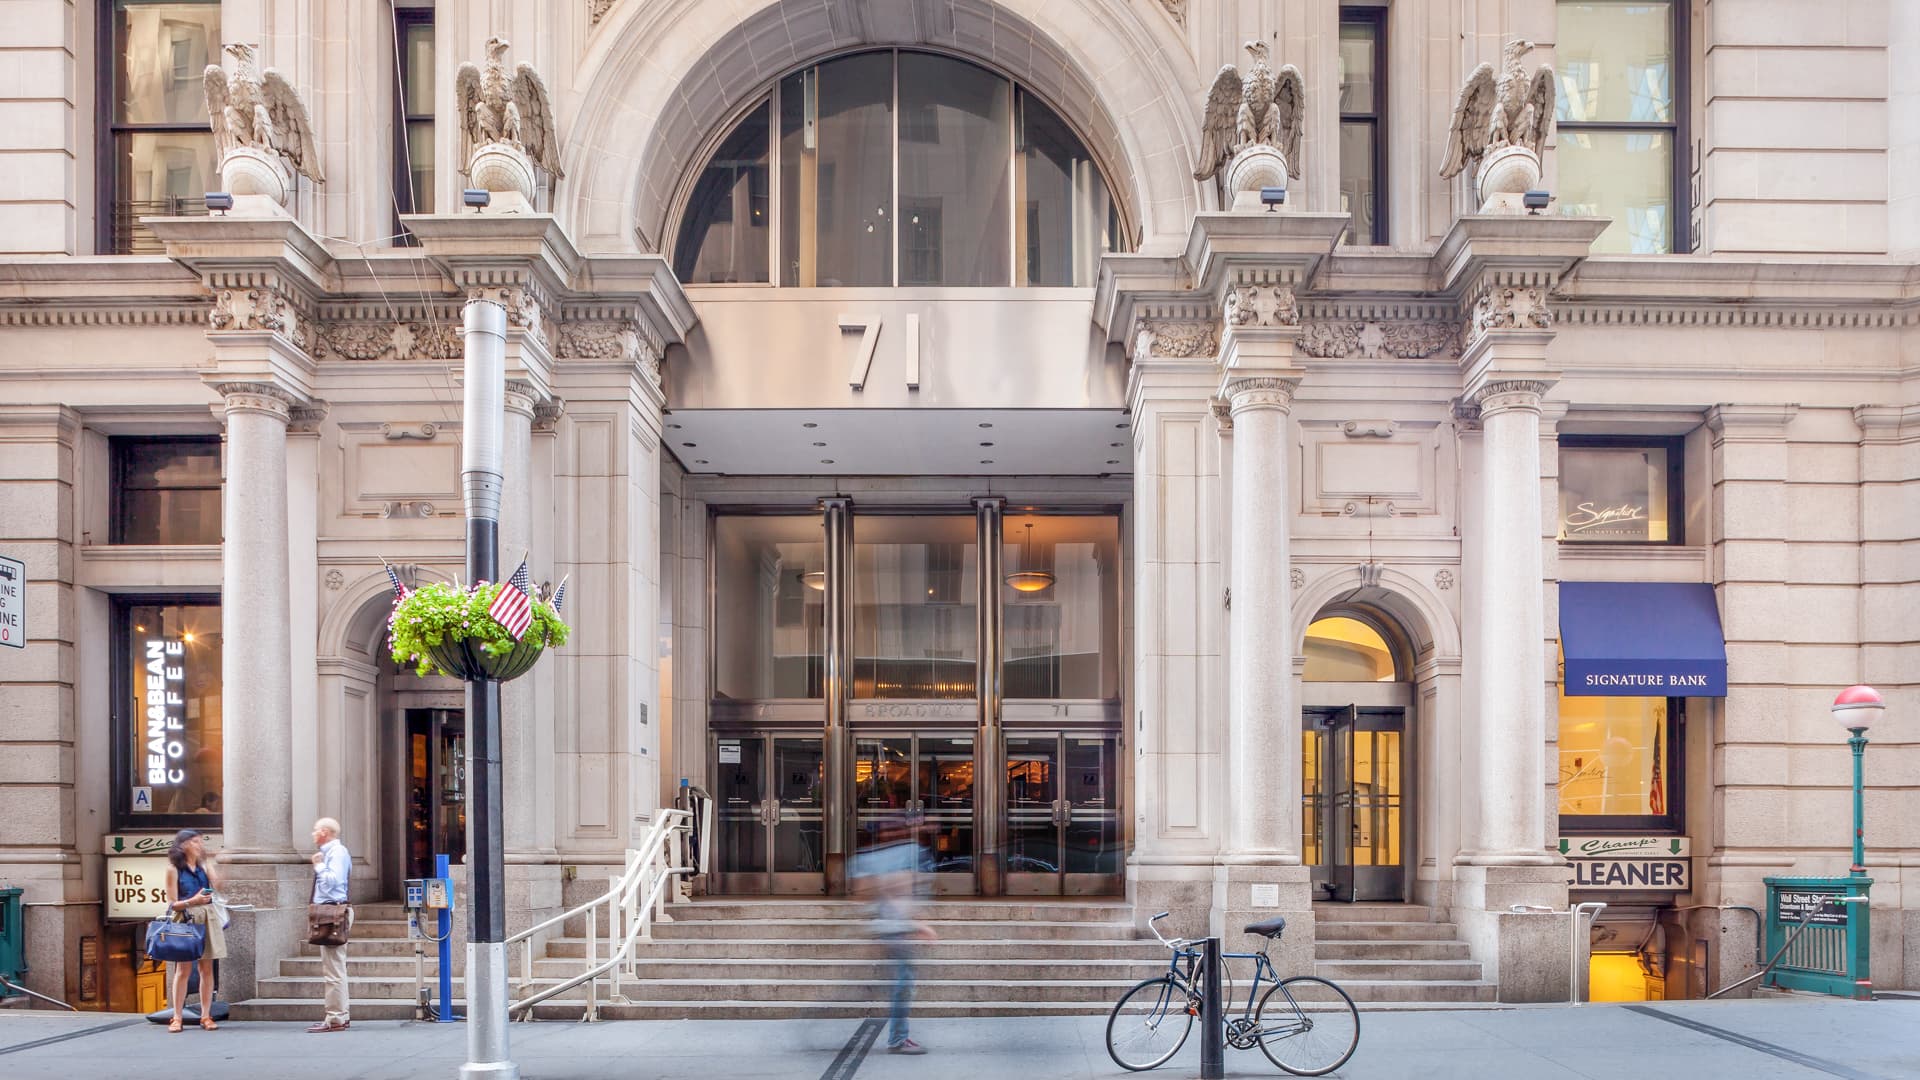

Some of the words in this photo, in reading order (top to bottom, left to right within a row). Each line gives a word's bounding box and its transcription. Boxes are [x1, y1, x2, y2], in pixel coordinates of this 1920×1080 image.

[838, 313, 919, 391] 71
[0, 584, 17, 598] INE
[0, 611, 18, 627] INE
[1586, 674, 1664, 686] SIGNATURE
[1669, 675, 1708, 686] BANK
[146, 640, 166, 785] BEAN&BEAN
[166, 641, 184, 784] COFFEE
[864, 703, 965, 718] BROADWAY
[1051, 703, 1069, 718] 71
[135, 789, 149, 805] A
[1580, 838, 1658, 852] Champs
[114, 870, 143, 886] The
[115, 888, 146, 903] UPS
[1793, 894, 1811, 904] Street
